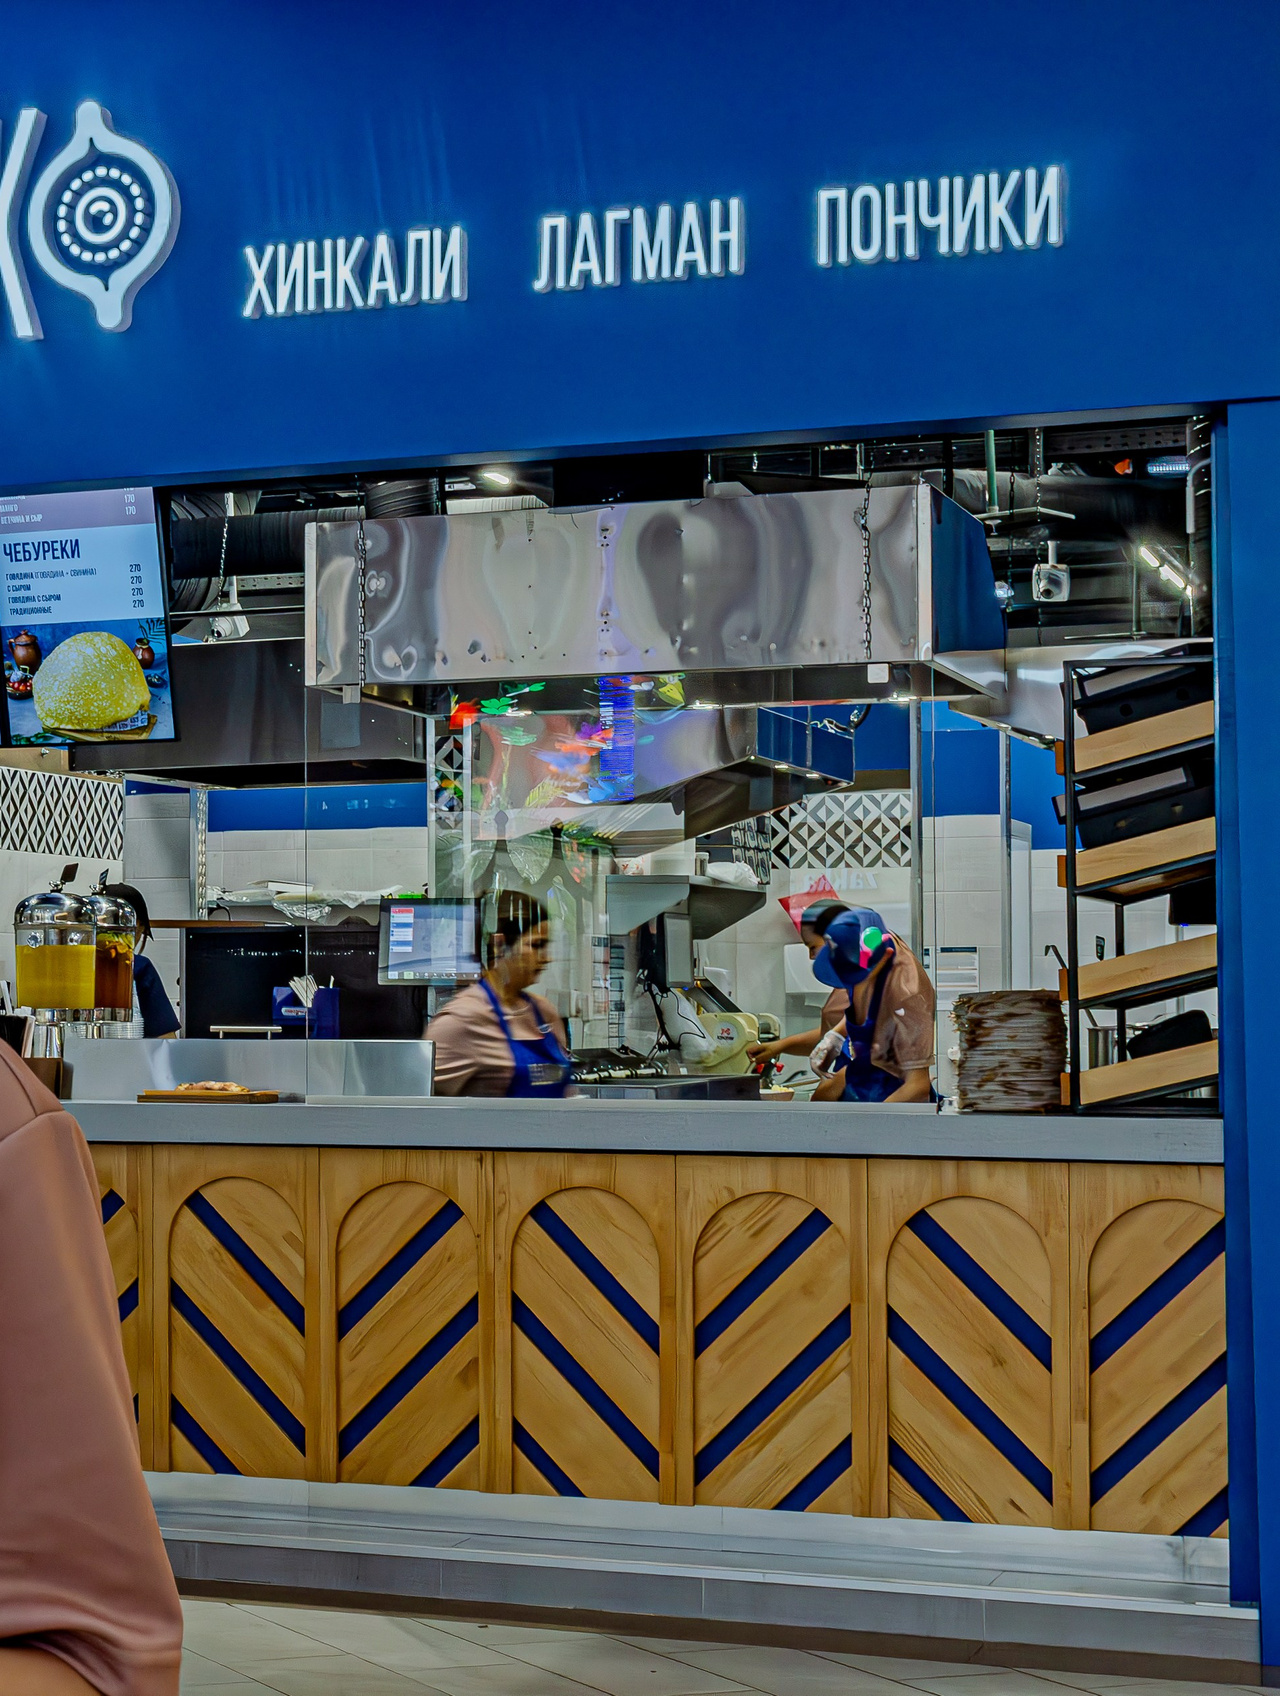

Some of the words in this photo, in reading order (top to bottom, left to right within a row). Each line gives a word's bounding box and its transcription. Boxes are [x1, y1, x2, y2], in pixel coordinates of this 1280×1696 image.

[816, 165, 1064, 268] ПОНЧИКИ
[533, 197, 745, 293] ЛАГМАН
[242, 226, 468, 318] ХИНКАЛИ
[3, 538, 80, 563] ЧЕБУРЕКИ
[130, 564, 141, 572] 270
[12, 584, 31, 592] СЫРОМ
[130, 576, 142, 584] 270
[42, 594, 61, 602] СЫРОМ
[132, 588, 144, 596] 270
[133, 599, 144, 608] 270
